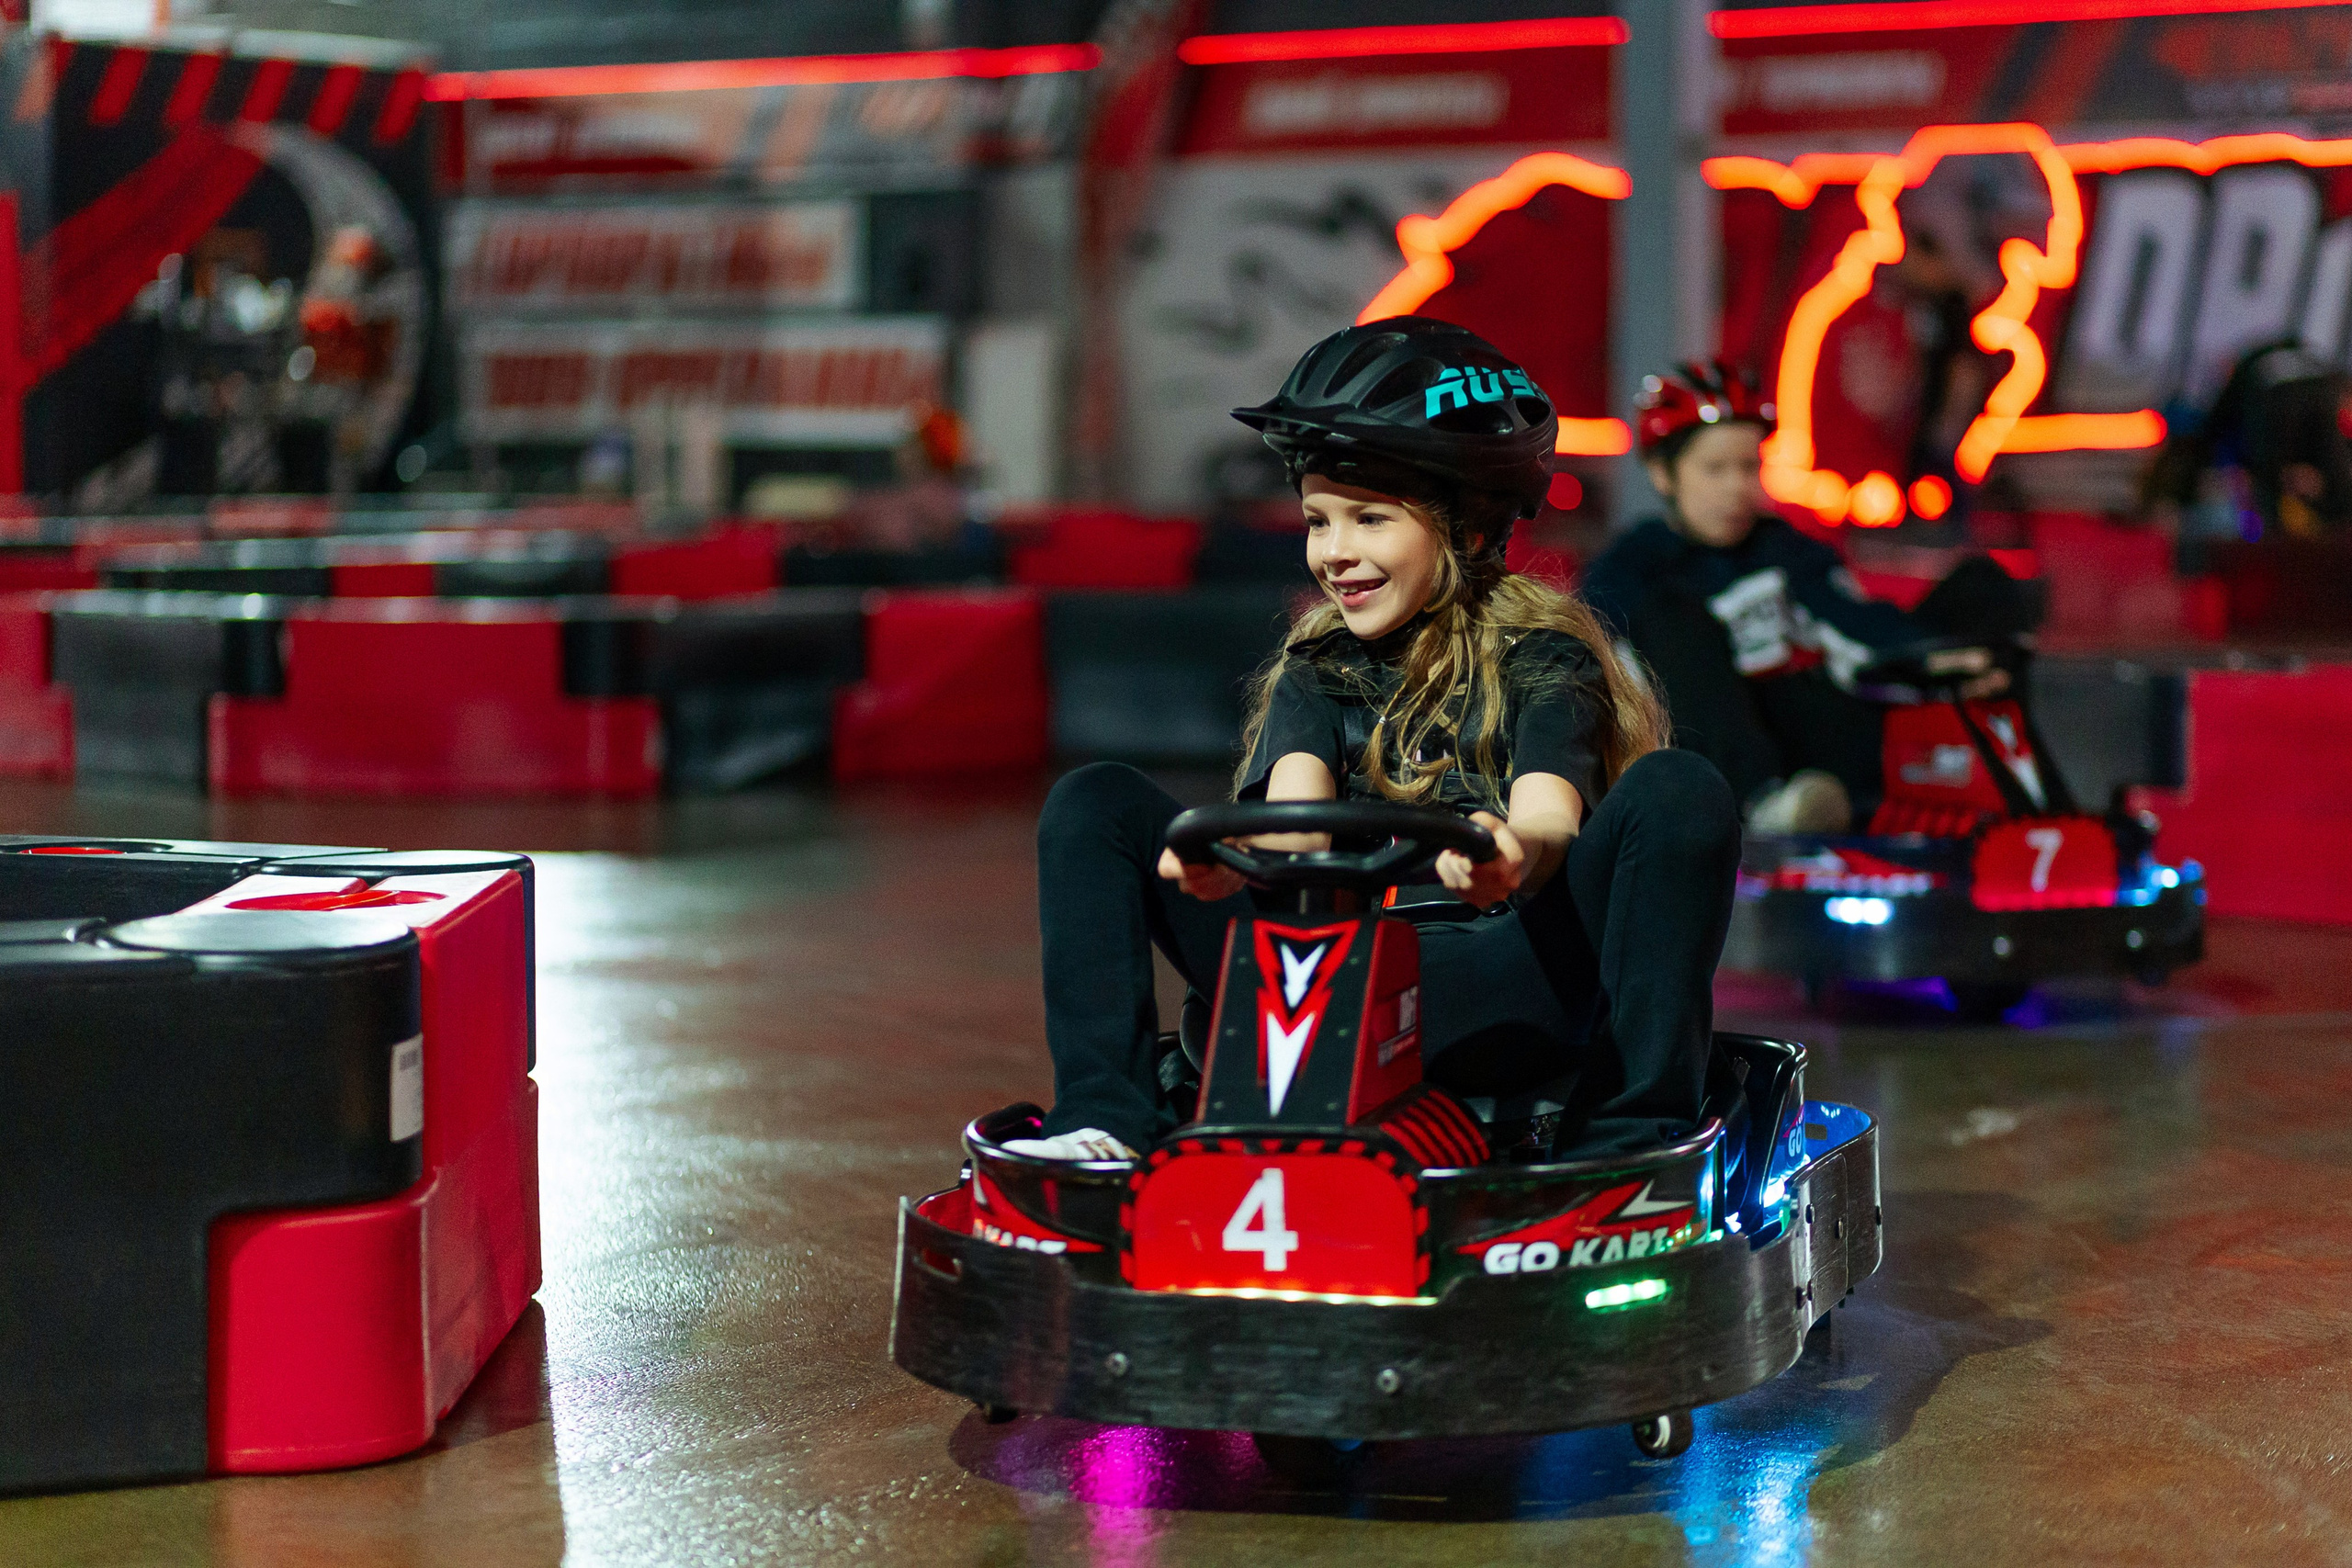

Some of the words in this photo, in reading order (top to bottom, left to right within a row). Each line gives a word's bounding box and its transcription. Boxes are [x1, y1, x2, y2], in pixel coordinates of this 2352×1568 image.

[2025, 827, 2064, 893] 7
[1222, 1167, 1299, 1272] 4
[1483, 1240, 1561, 1275] GO
